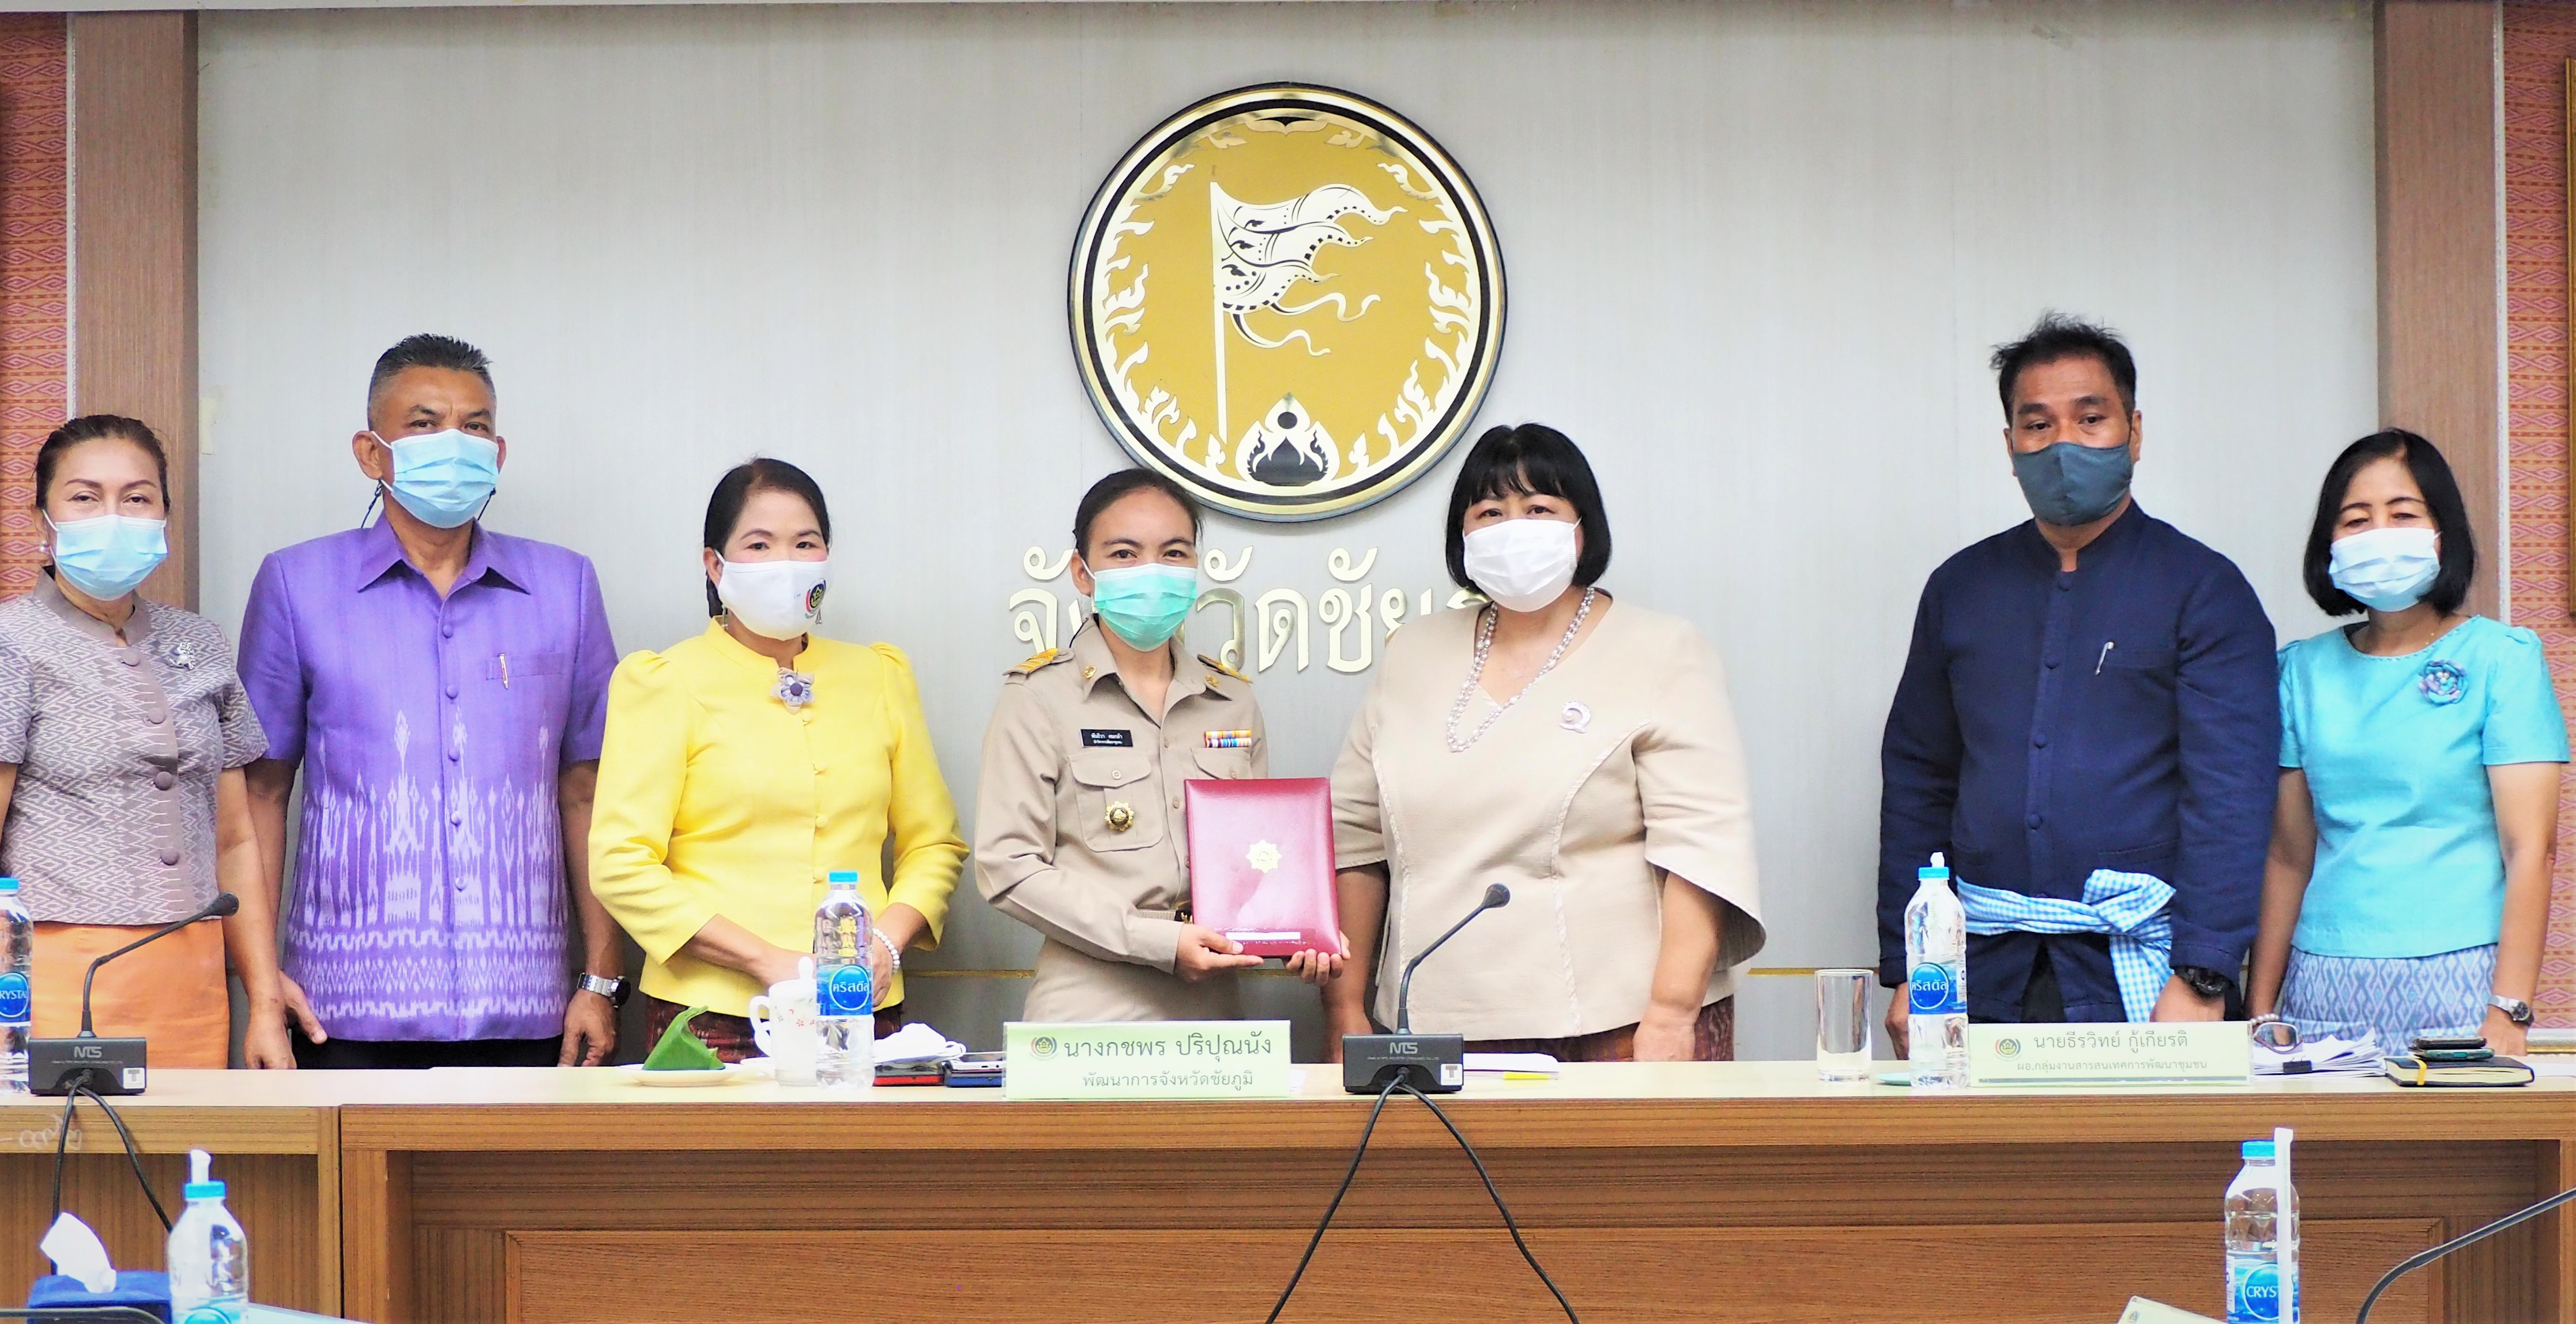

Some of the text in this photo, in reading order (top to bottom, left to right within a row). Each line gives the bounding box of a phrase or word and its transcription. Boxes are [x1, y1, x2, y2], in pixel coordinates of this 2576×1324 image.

[1064, 1030, 1271, 1062] นางกชพร ปริปุณนัง
[2033, 1029, 2189, 1054] นายธีรวิทย์ กู้เกียรติ
[1083, 1070, 1253, 1091] พัฒนาการจังหวัดชัยภูมิ
